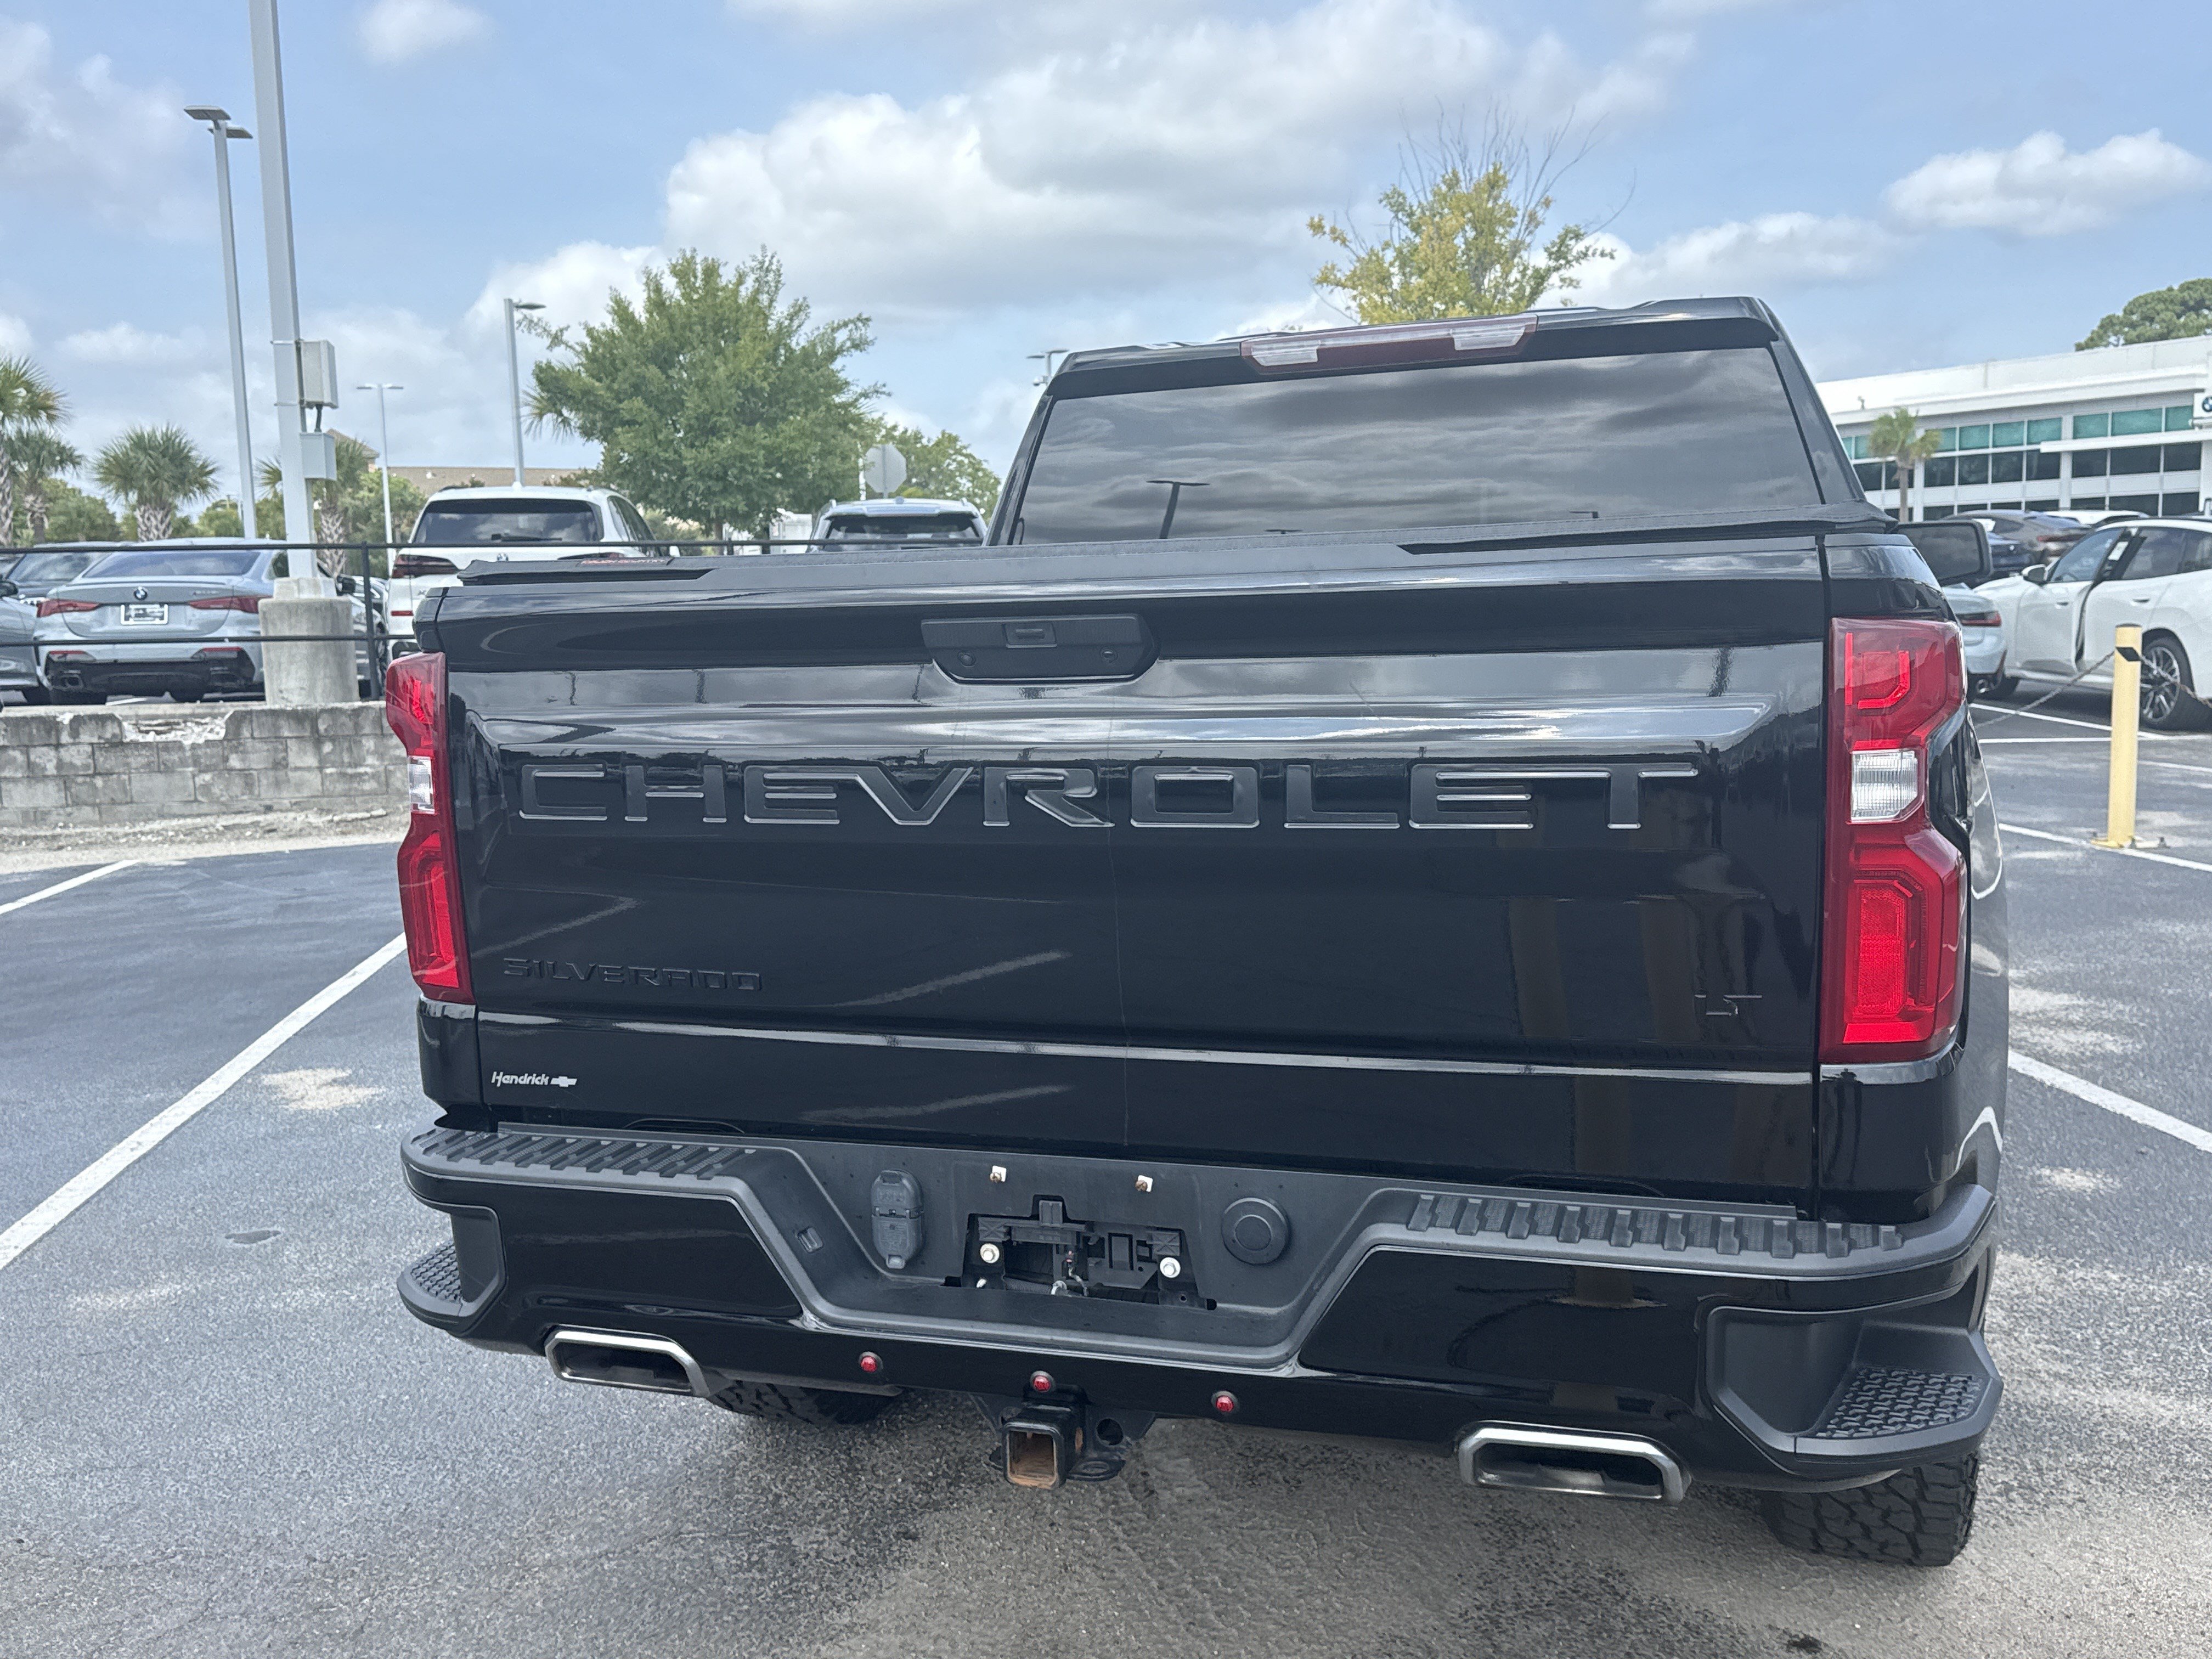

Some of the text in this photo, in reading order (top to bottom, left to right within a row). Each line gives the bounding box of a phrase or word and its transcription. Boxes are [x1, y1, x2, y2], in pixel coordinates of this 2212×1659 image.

[519, 761, 1699, 830] CHEVROLET
[503, 957, 762, 991] SILVERADO
[491, 1071, 549, 1087] Hendrick
